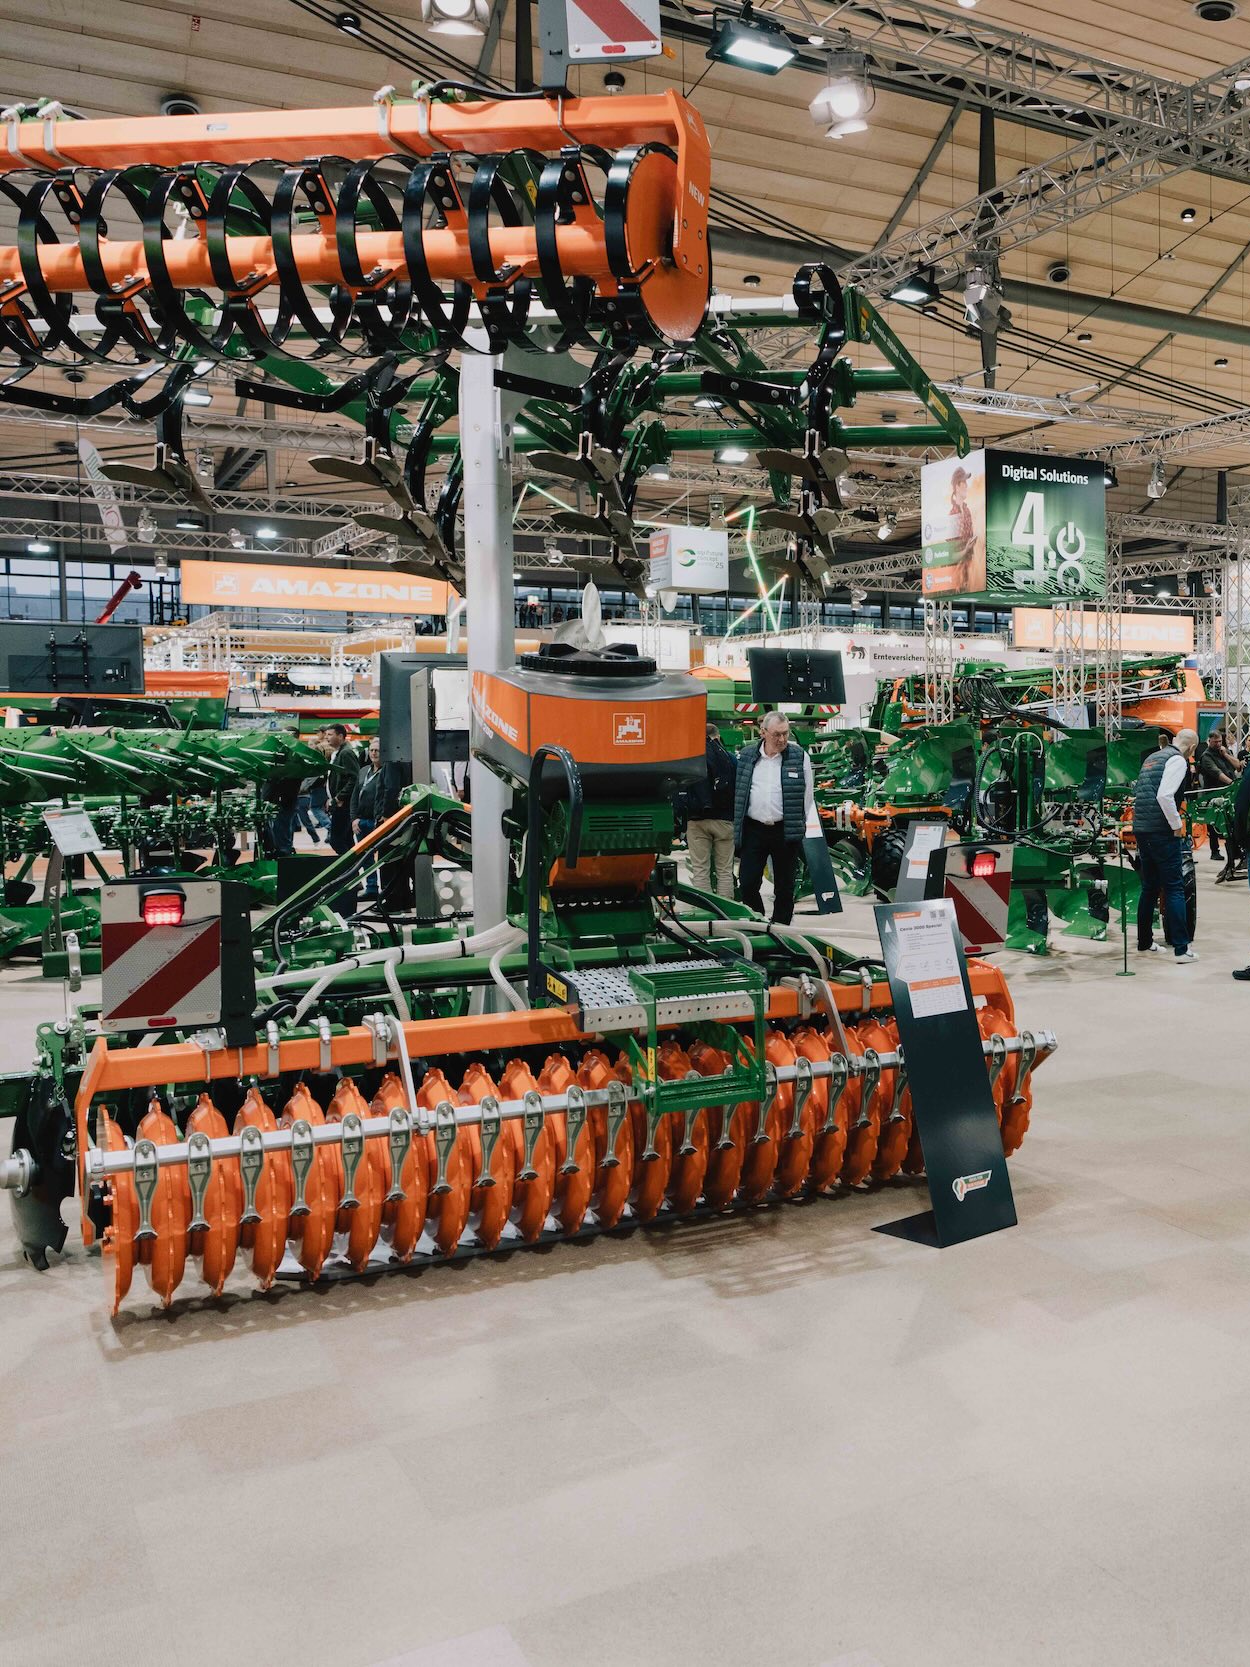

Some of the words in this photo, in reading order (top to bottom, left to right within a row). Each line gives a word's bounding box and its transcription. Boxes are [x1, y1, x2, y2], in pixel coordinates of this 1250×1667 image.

[688, 180, 705, 208] NEW
[1002, 464, 1038, 482] Digital
[1039, 467, 1089, 486] Solutions
[250, 577, 433, 602] AMAZONE
[144, 690, 212, 698] AMAZONE
